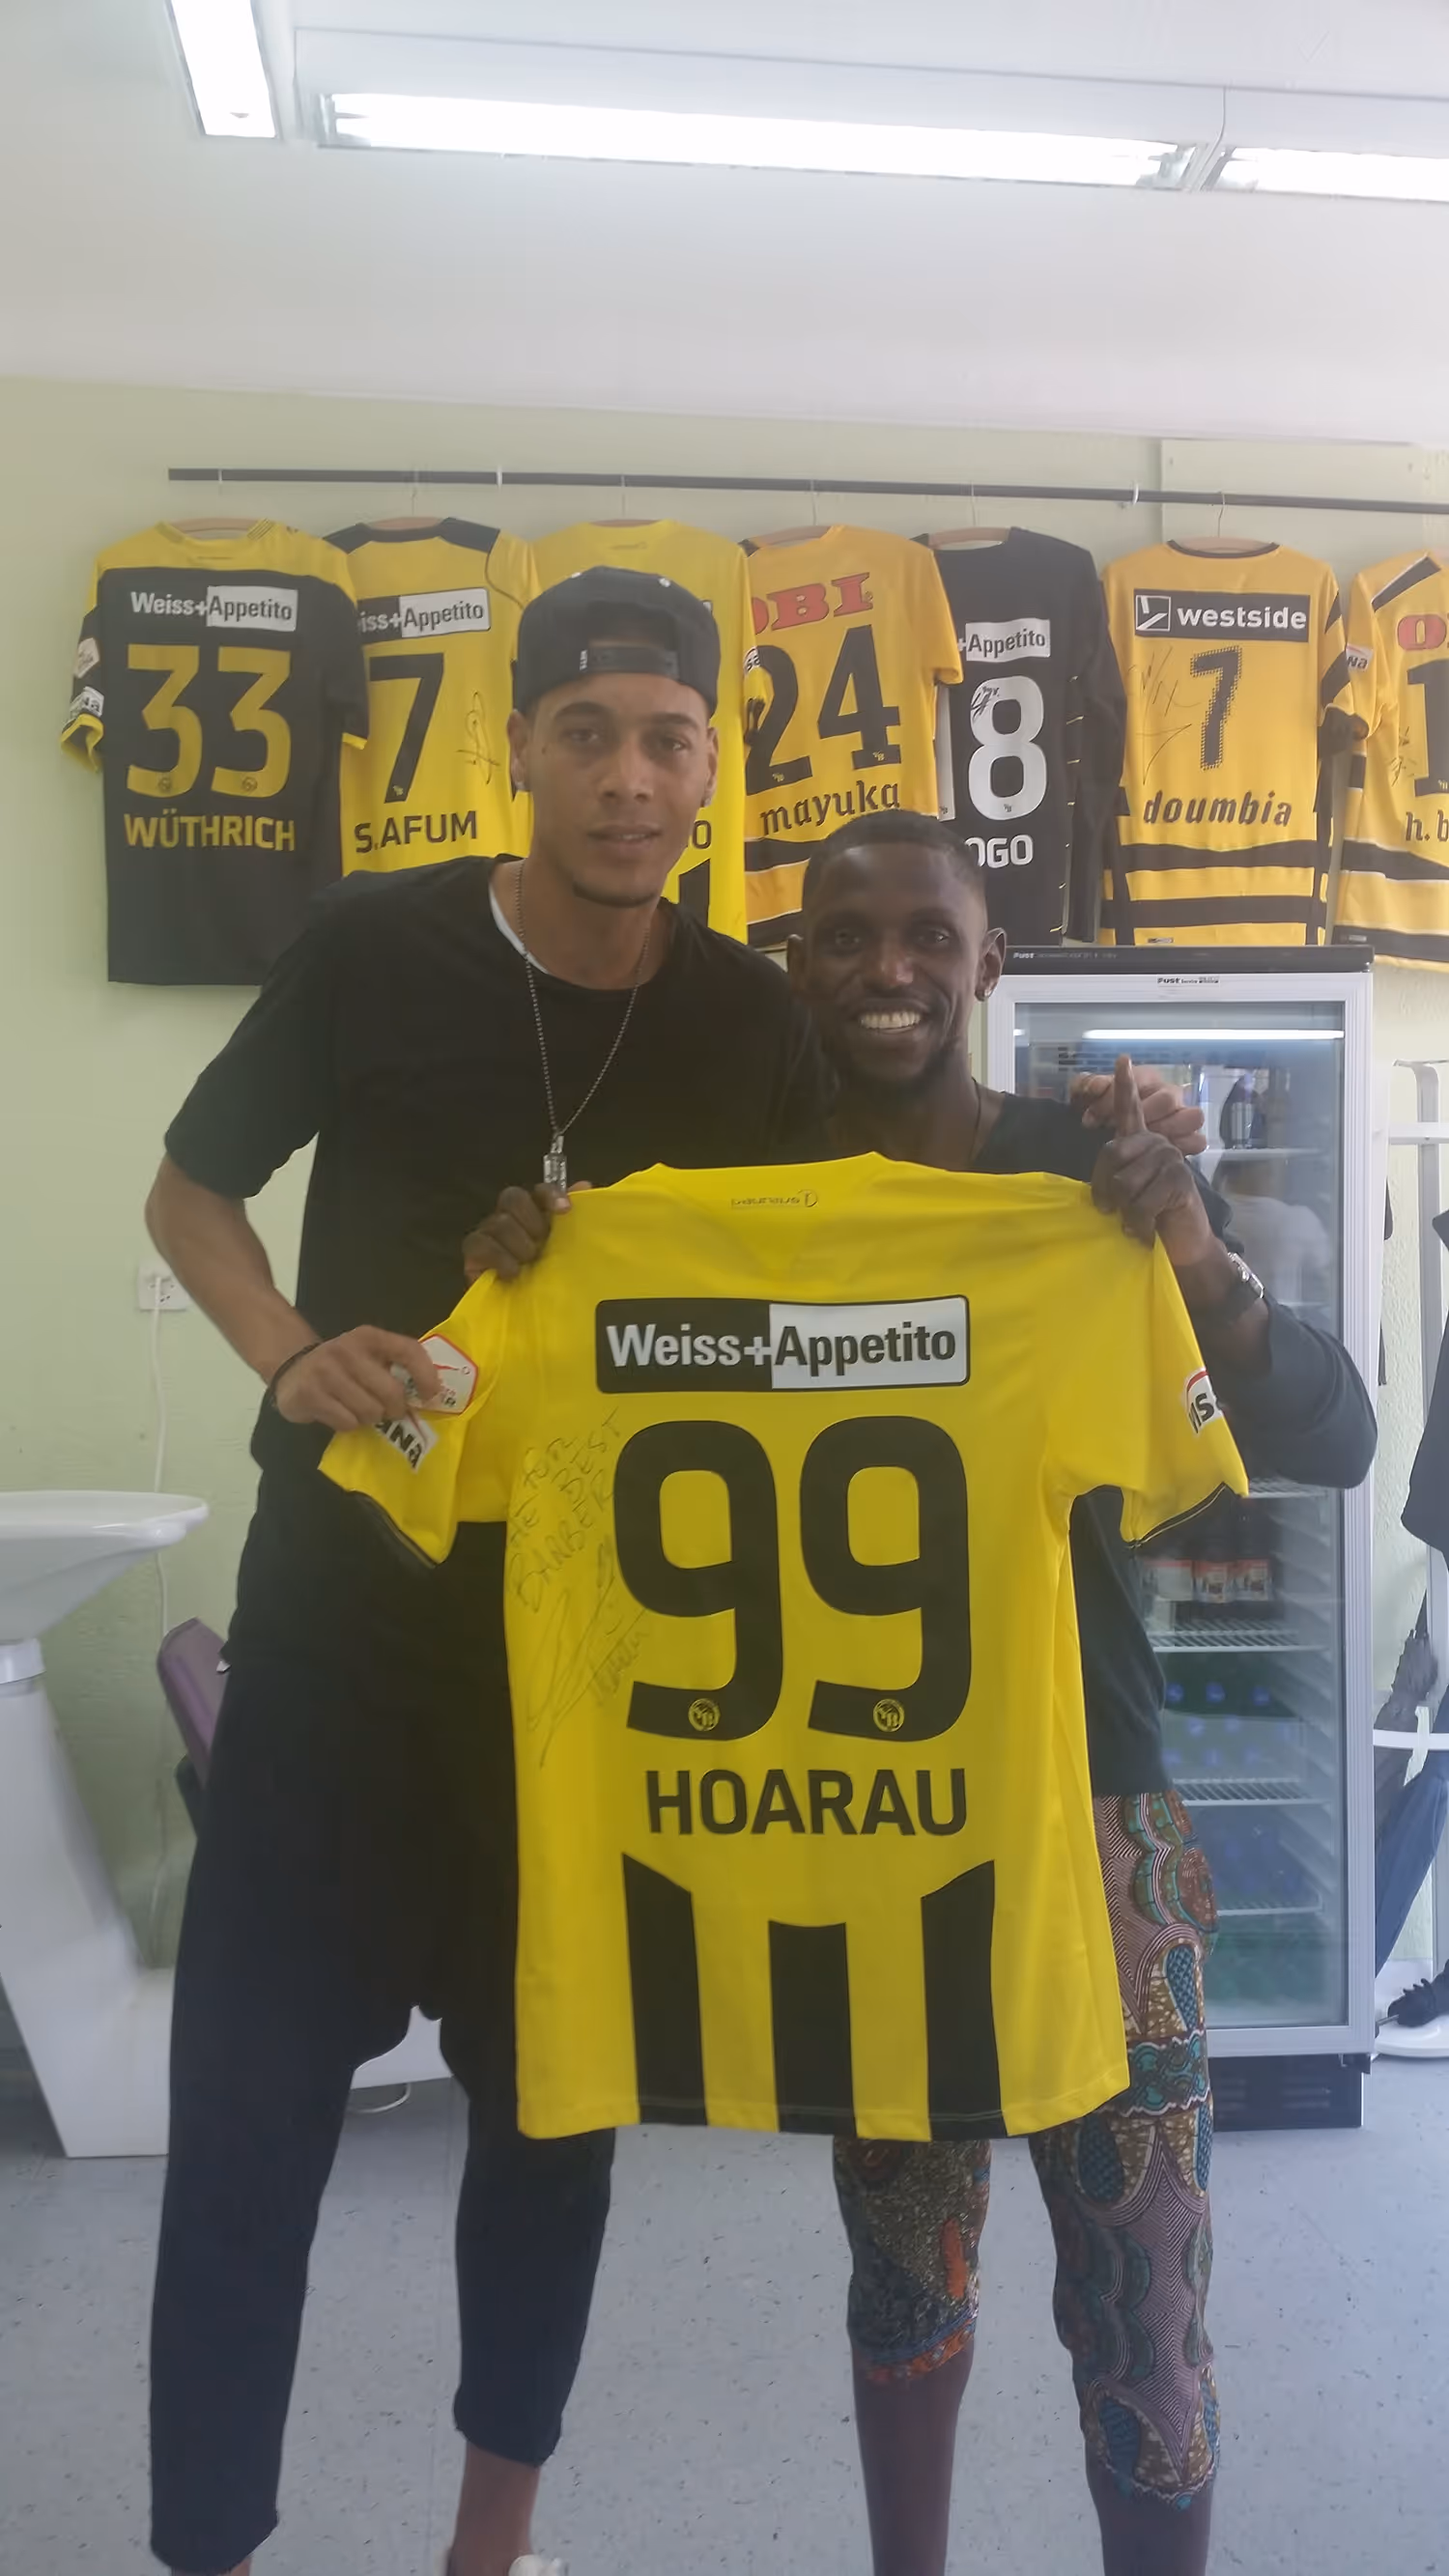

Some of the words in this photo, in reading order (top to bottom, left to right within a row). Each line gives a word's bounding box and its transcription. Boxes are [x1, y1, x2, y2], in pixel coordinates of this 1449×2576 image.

[130, 591, 293, 622] Weiss+Appetito
[357, 601, 484, 632] iss+Appetito
[1177, 606, 1307, 631] westside
[127, 643, 291, 798] 33
[369, 652, 444, 804] 7
[745, 624, 901, 796] 24
[1190, 644, 1242, 771] 7
[124, 808, 296, 851] WÜTHRICH
[759, 779, 901, 836] mayuka
[1142, 790, 1293, 827] doumbia
[607, 1320, 955, 1376] Weiss+Appetito
[612, 1415, 972, 1742] 99
[645, 1768, 967, 1836] HOARAU
